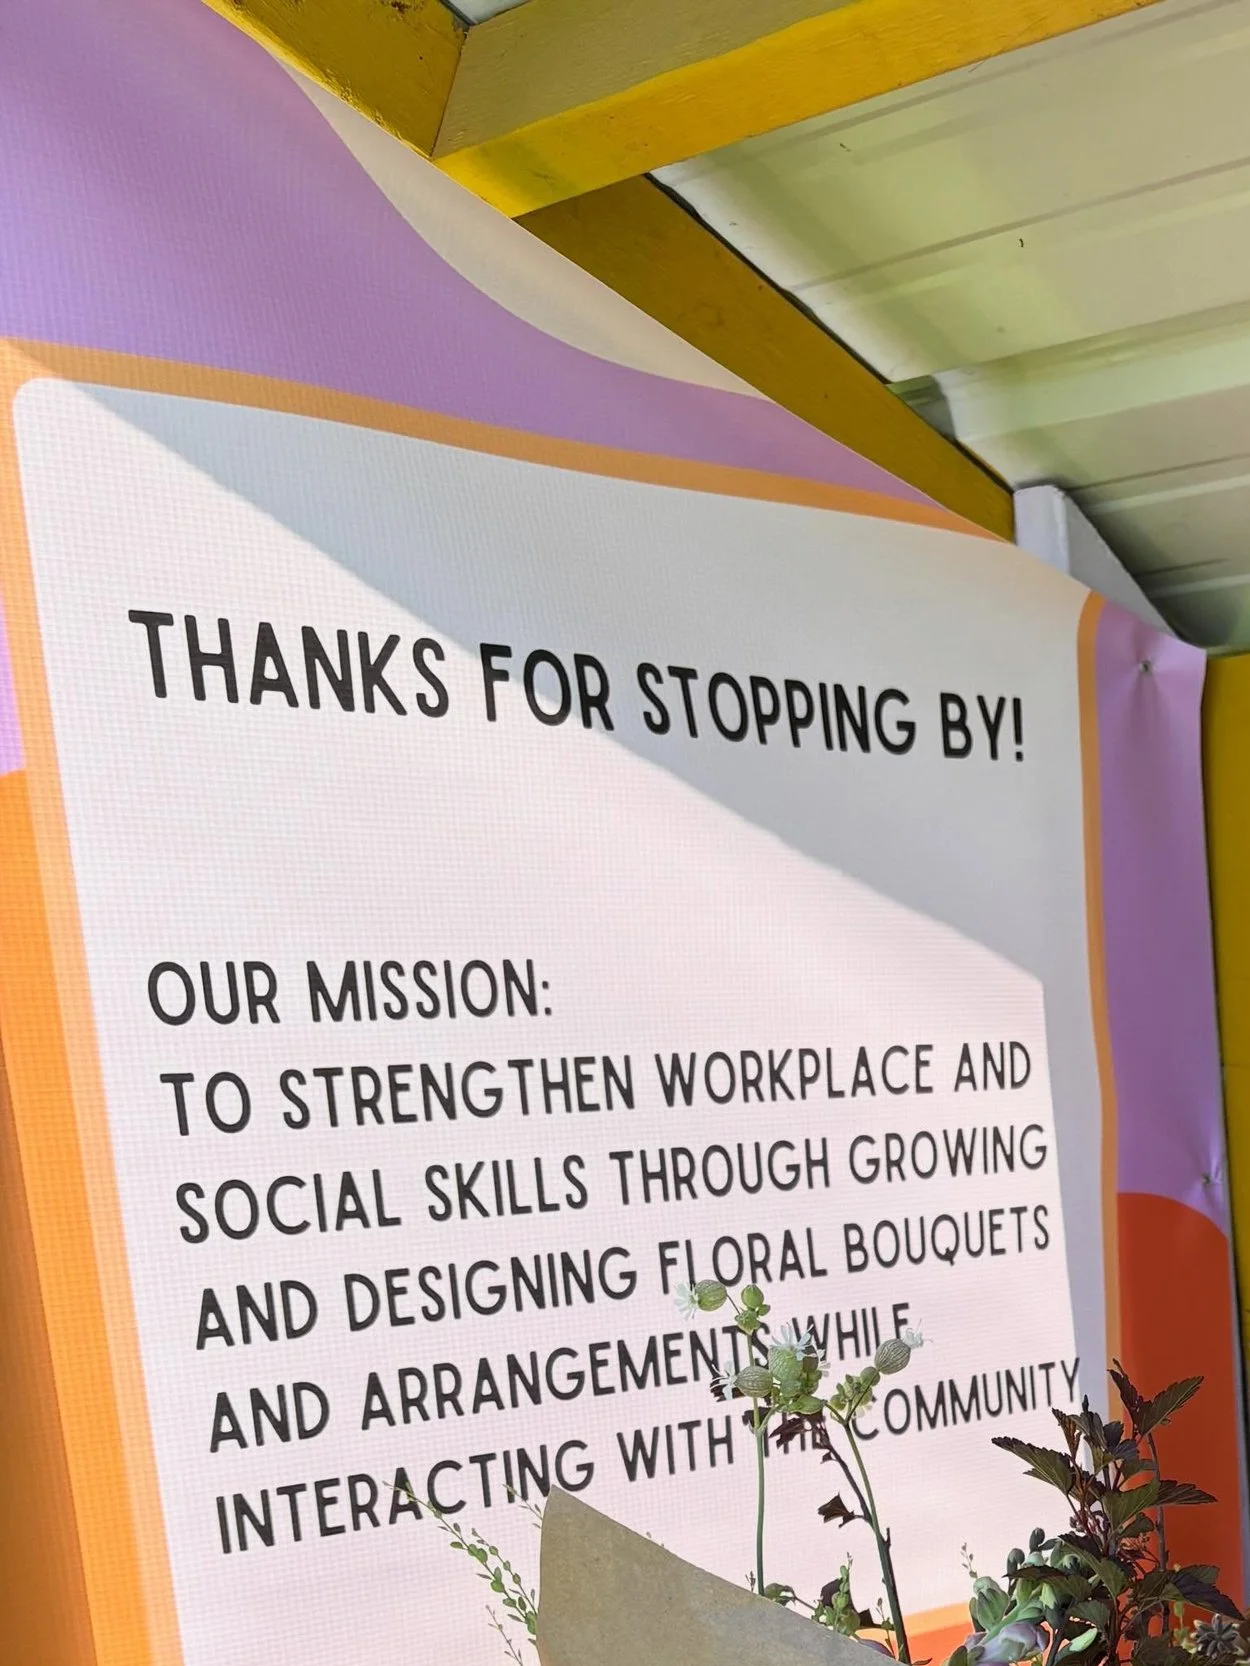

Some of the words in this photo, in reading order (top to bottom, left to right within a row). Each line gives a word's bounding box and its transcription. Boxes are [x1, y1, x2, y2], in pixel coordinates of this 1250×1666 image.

[128, 609, 449, 718] THANKS
[478, 642, 615, 731] FOR
[634, 660, 918, 756] STOPPING
[940, 690, 1028, 763] BY!
[146, 960, 282, 1026] OUR
[305, 958, 556, 1022] MISSION:
[158, 1070, 254, 1138] TO
[279, 1053, 637, 1130] STRENGTHEN
[654, 1044, 934, 1107] WORKPLACE
[952, 1040, 1034, 1092] AND
[175, 1167, 403, 1245] SOCIAL
[424, 1155, 588, 1222] SKILLS
[608, 1137, 831, 1205] THROUGH
[847, 1123, 1048, 1185] GROWING
[194, 1278, 320, 1350] AND
[343, 1243, 640, 1334] DESIGNING
[657, 1227, 828, 1296] FLORAL
[843, 1204, 1052, 1272] BOUQUETS
[208, 1380, 332, 1455] AND
[358, 1325, 770, 1431] ARRANGEMENTS
[213, 1438, 597, 1556] INTERACTING
[614, 1415, 736, 1483] WITH
